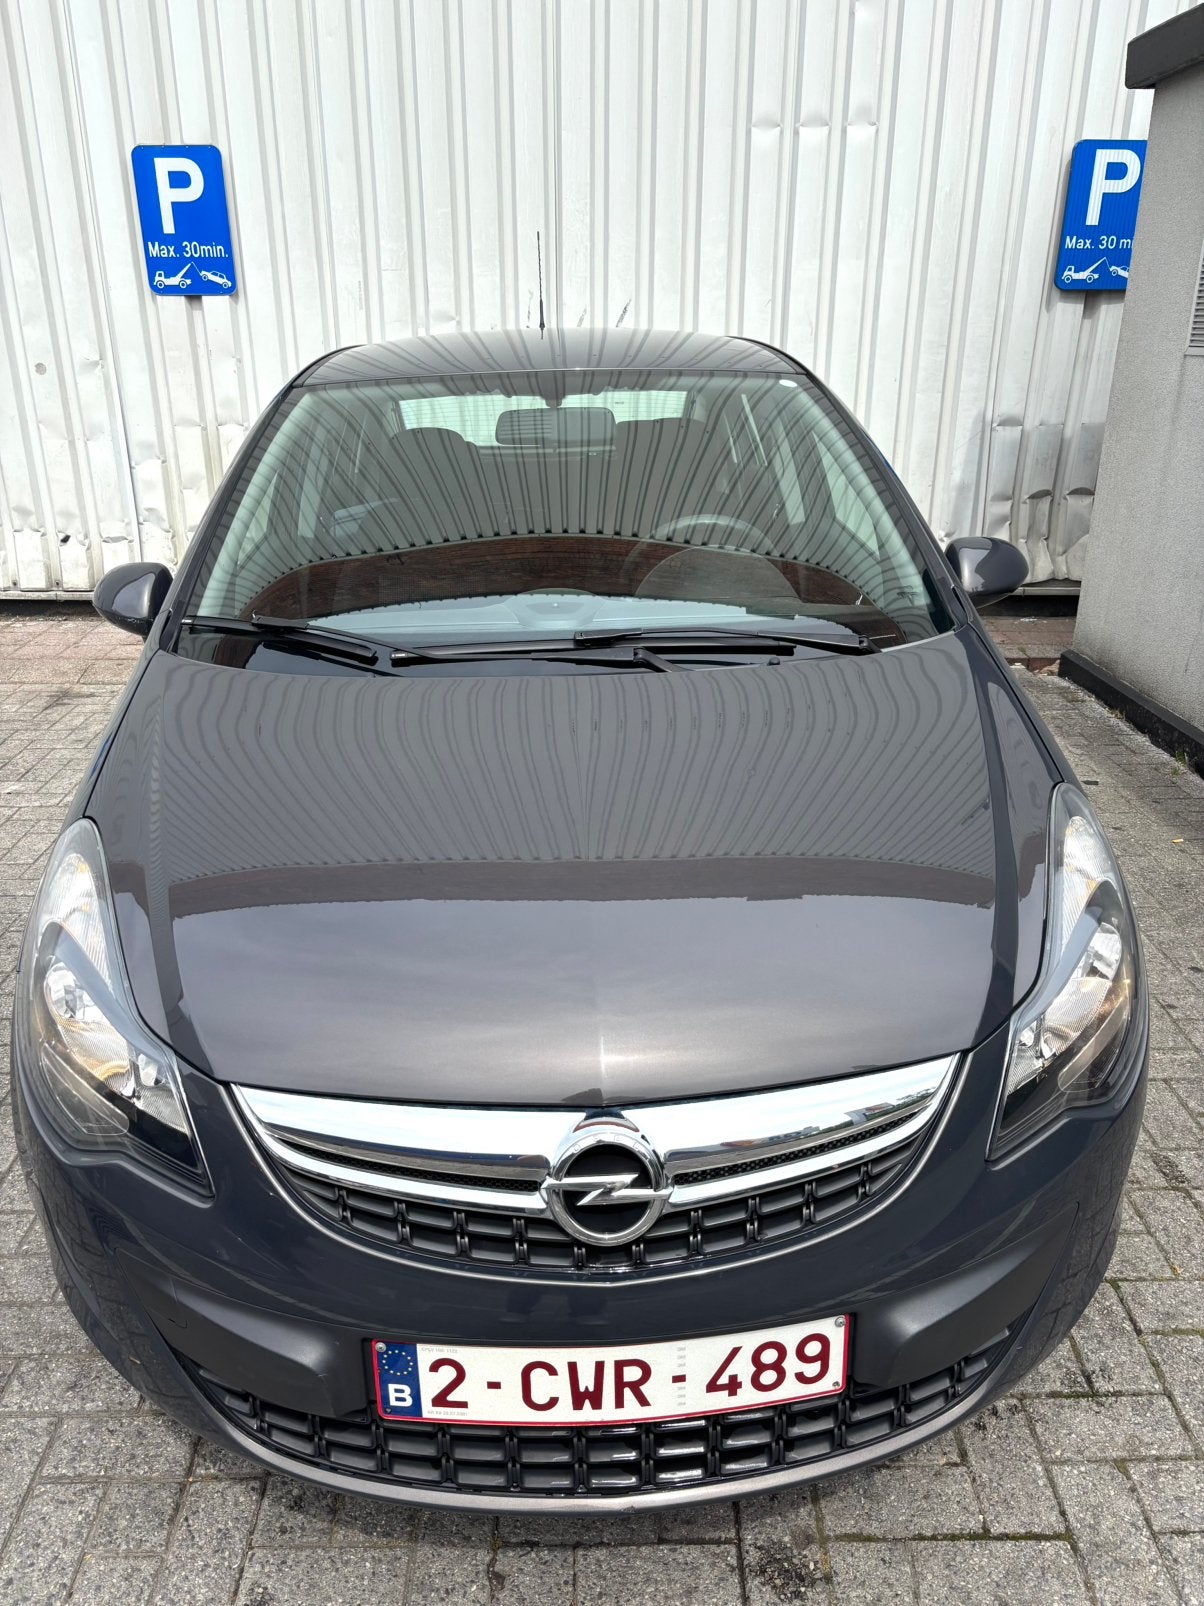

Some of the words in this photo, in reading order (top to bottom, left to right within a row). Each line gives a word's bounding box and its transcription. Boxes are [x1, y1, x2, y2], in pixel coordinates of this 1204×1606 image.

[153, 157, 205, 234] P
[1085, 148, 1141, 226] P
[147, 241, 180, 258] Max.
[1065, 235, 1095, 249] Max.
[1098, 235, 1117, 249] 30
[387, 1383, 413, 1407] B
